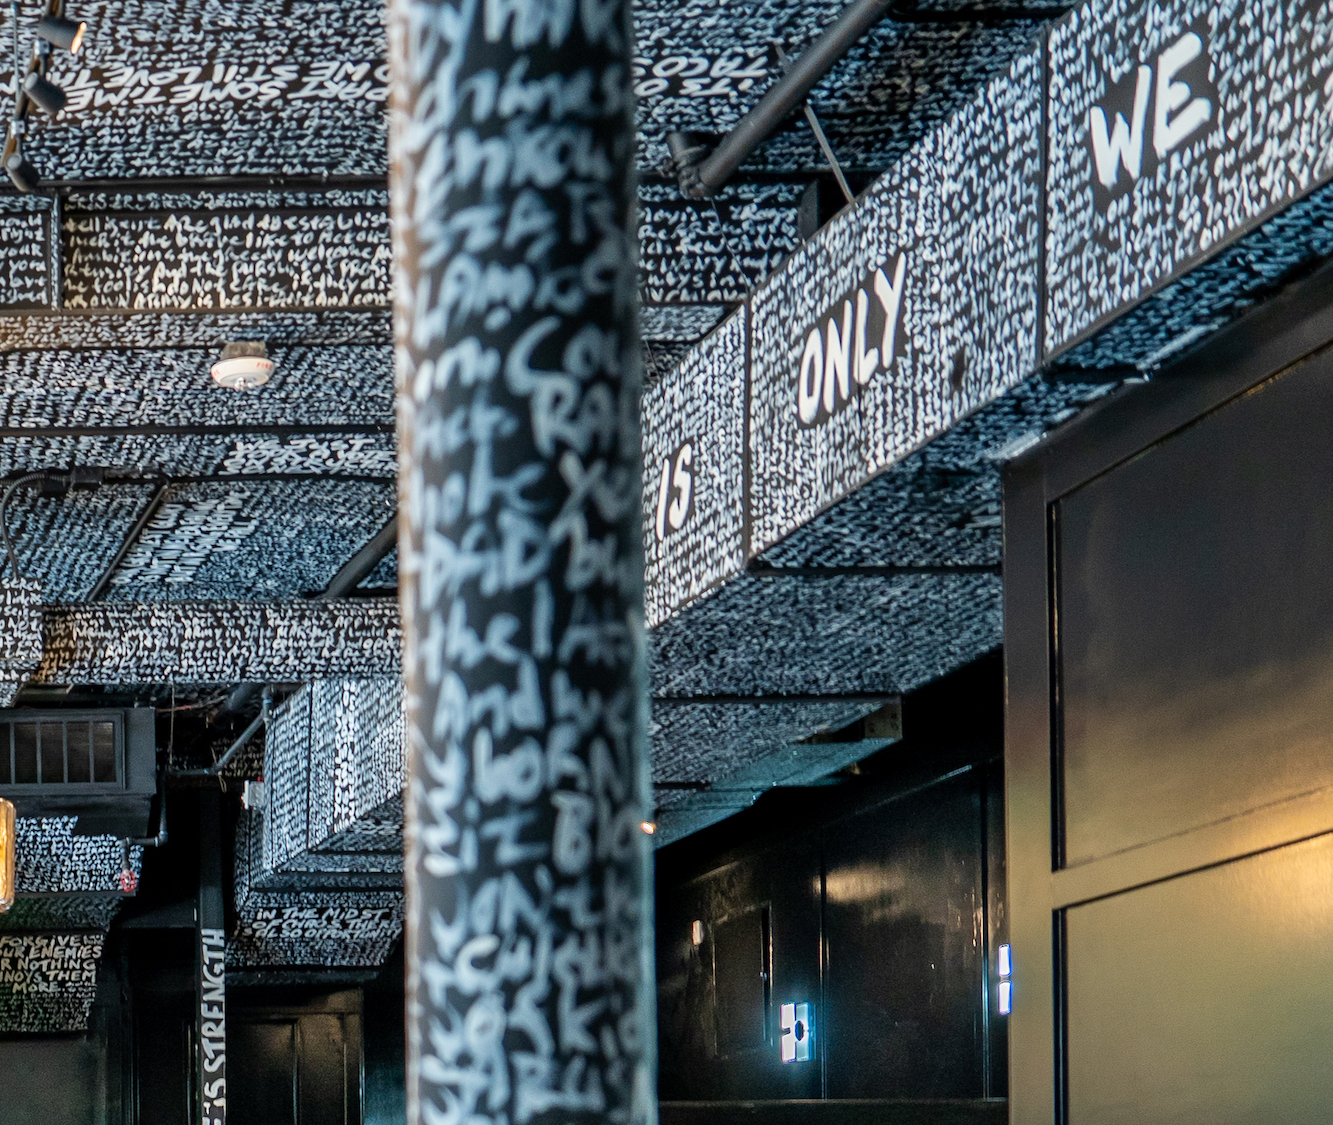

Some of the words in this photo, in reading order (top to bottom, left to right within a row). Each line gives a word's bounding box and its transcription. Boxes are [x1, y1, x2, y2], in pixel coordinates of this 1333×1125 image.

[109, 67, 200, 88] LOVE
[1091, 31, 1212, 186] WE
[799, 252, 906, 424] ONLY
[656, 441, 693, 539] IS
[0, 935, 81, 949] FORGIVE
[29, 945, 102, 960] ENEMIES
[18, 956, 96, 972] NOTHING
[46, 970, 96, 984] THEM
[200, 928, 226, 1075] STRENGTH
